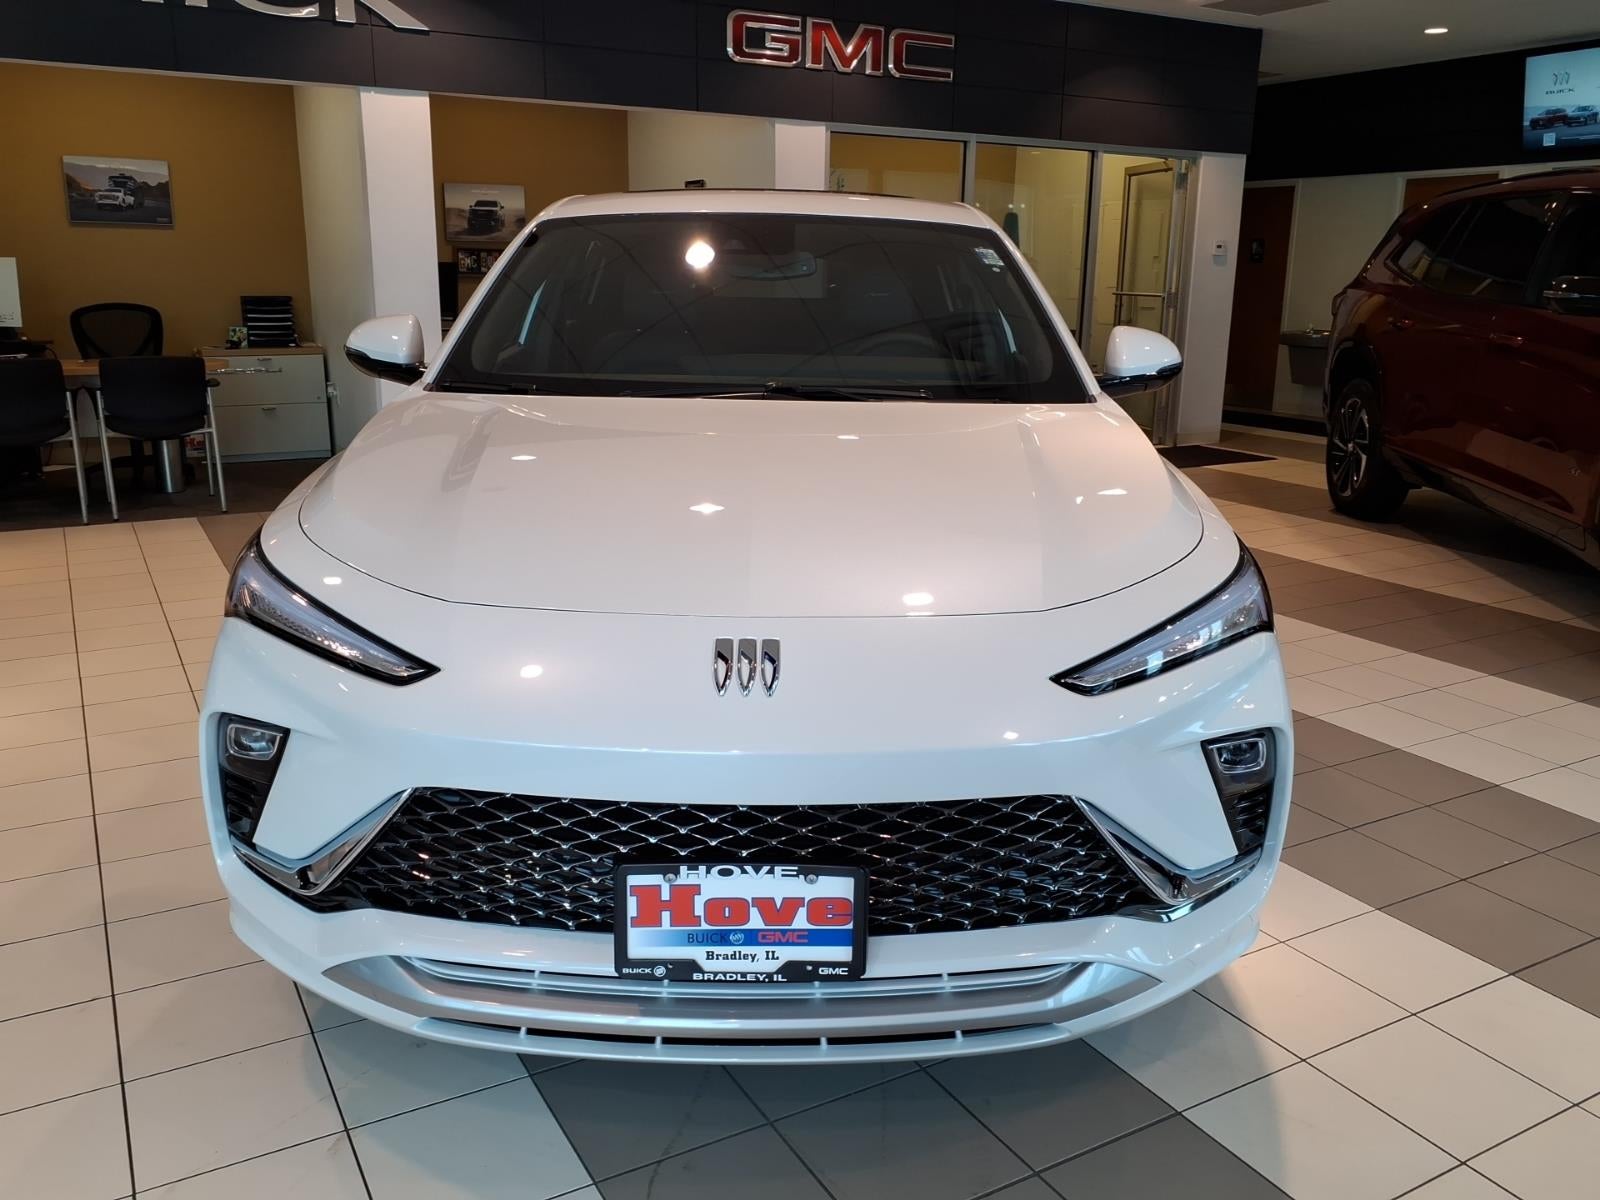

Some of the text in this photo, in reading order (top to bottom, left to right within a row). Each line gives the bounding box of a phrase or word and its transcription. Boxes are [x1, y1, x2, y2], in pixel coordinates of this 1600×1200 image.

[726, 9, 955, 82] GMC
[679, 865, 799, 880] HOVE
[630, 884, 853, 928] Hove
[687, 931, 808, 944] BUICK GMC
[705, 950, 779, 962] Bradley, IL
[622, 967, 652, 975] BUICK
[818, 967, 848, 975] GMC
[692, 973, 788, 982] BRADLEY, IL
